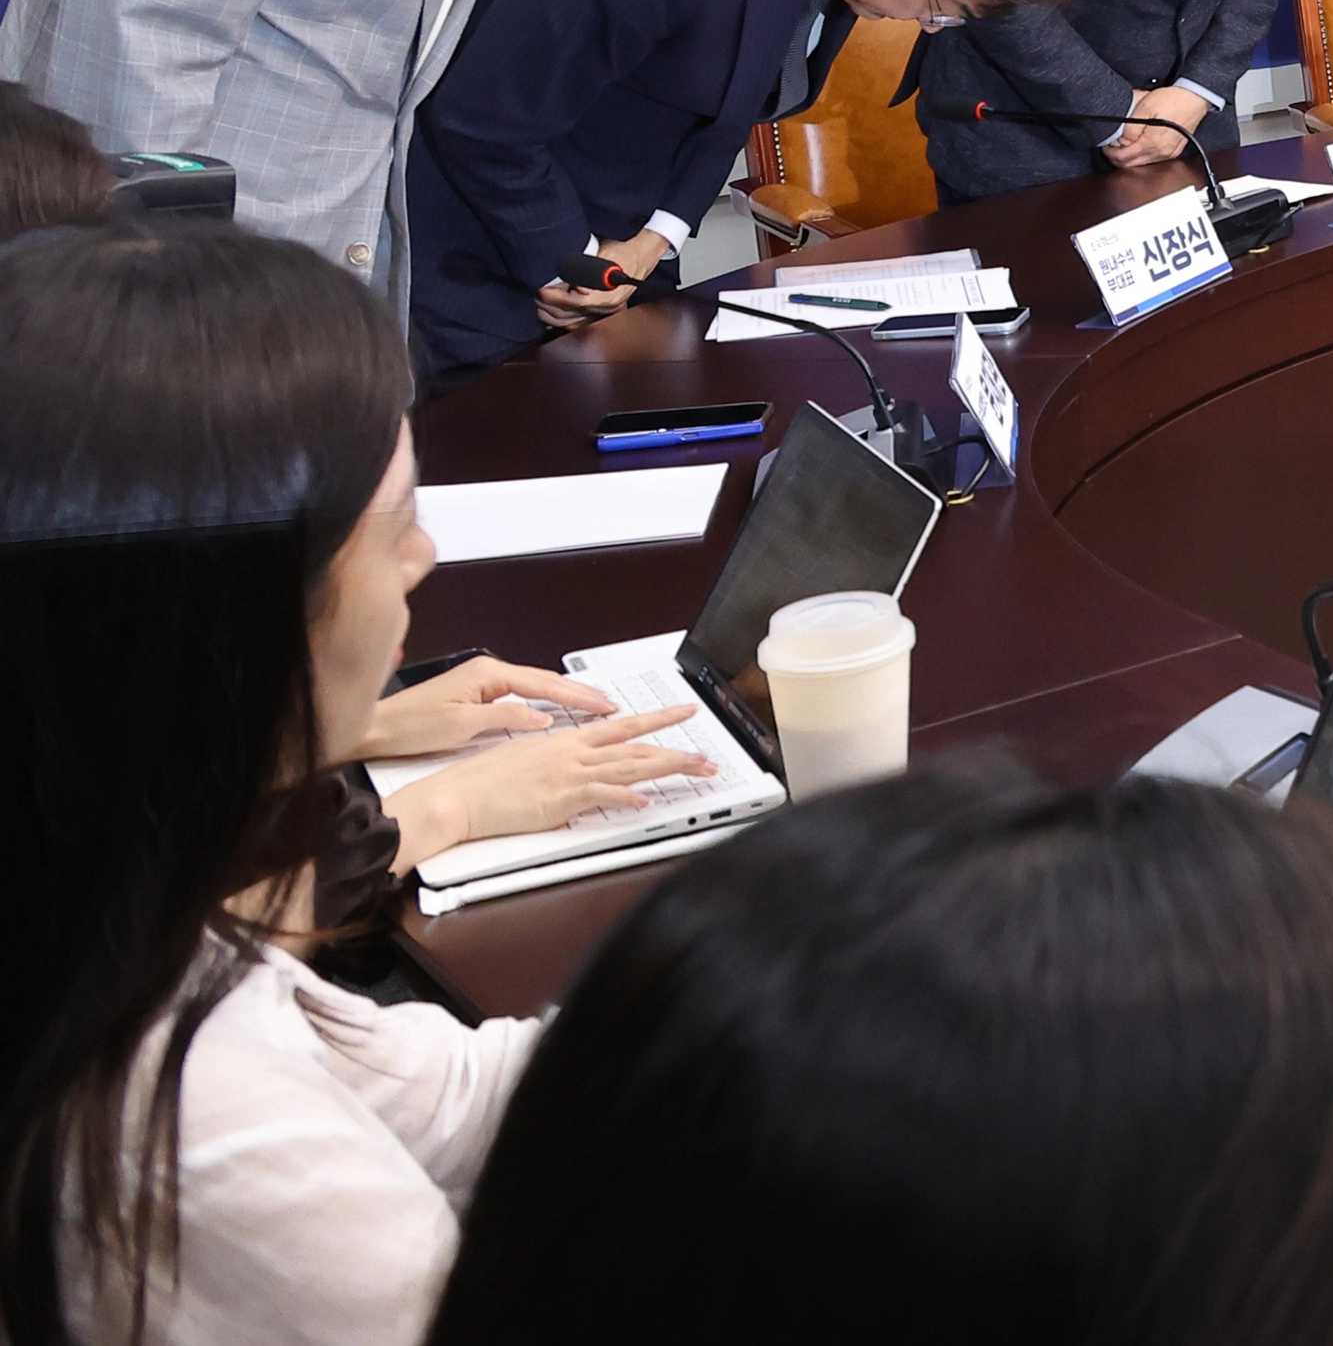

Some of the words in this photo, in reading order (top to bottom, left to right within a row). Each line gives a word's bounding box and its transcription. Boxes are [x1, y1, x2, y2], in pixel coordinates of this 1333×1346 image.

[1098, 247, 1136, 276] 원내수석
[1142, 216, 1215, 283] 신장식
[1106, 269, 1136, 293] 부대표
